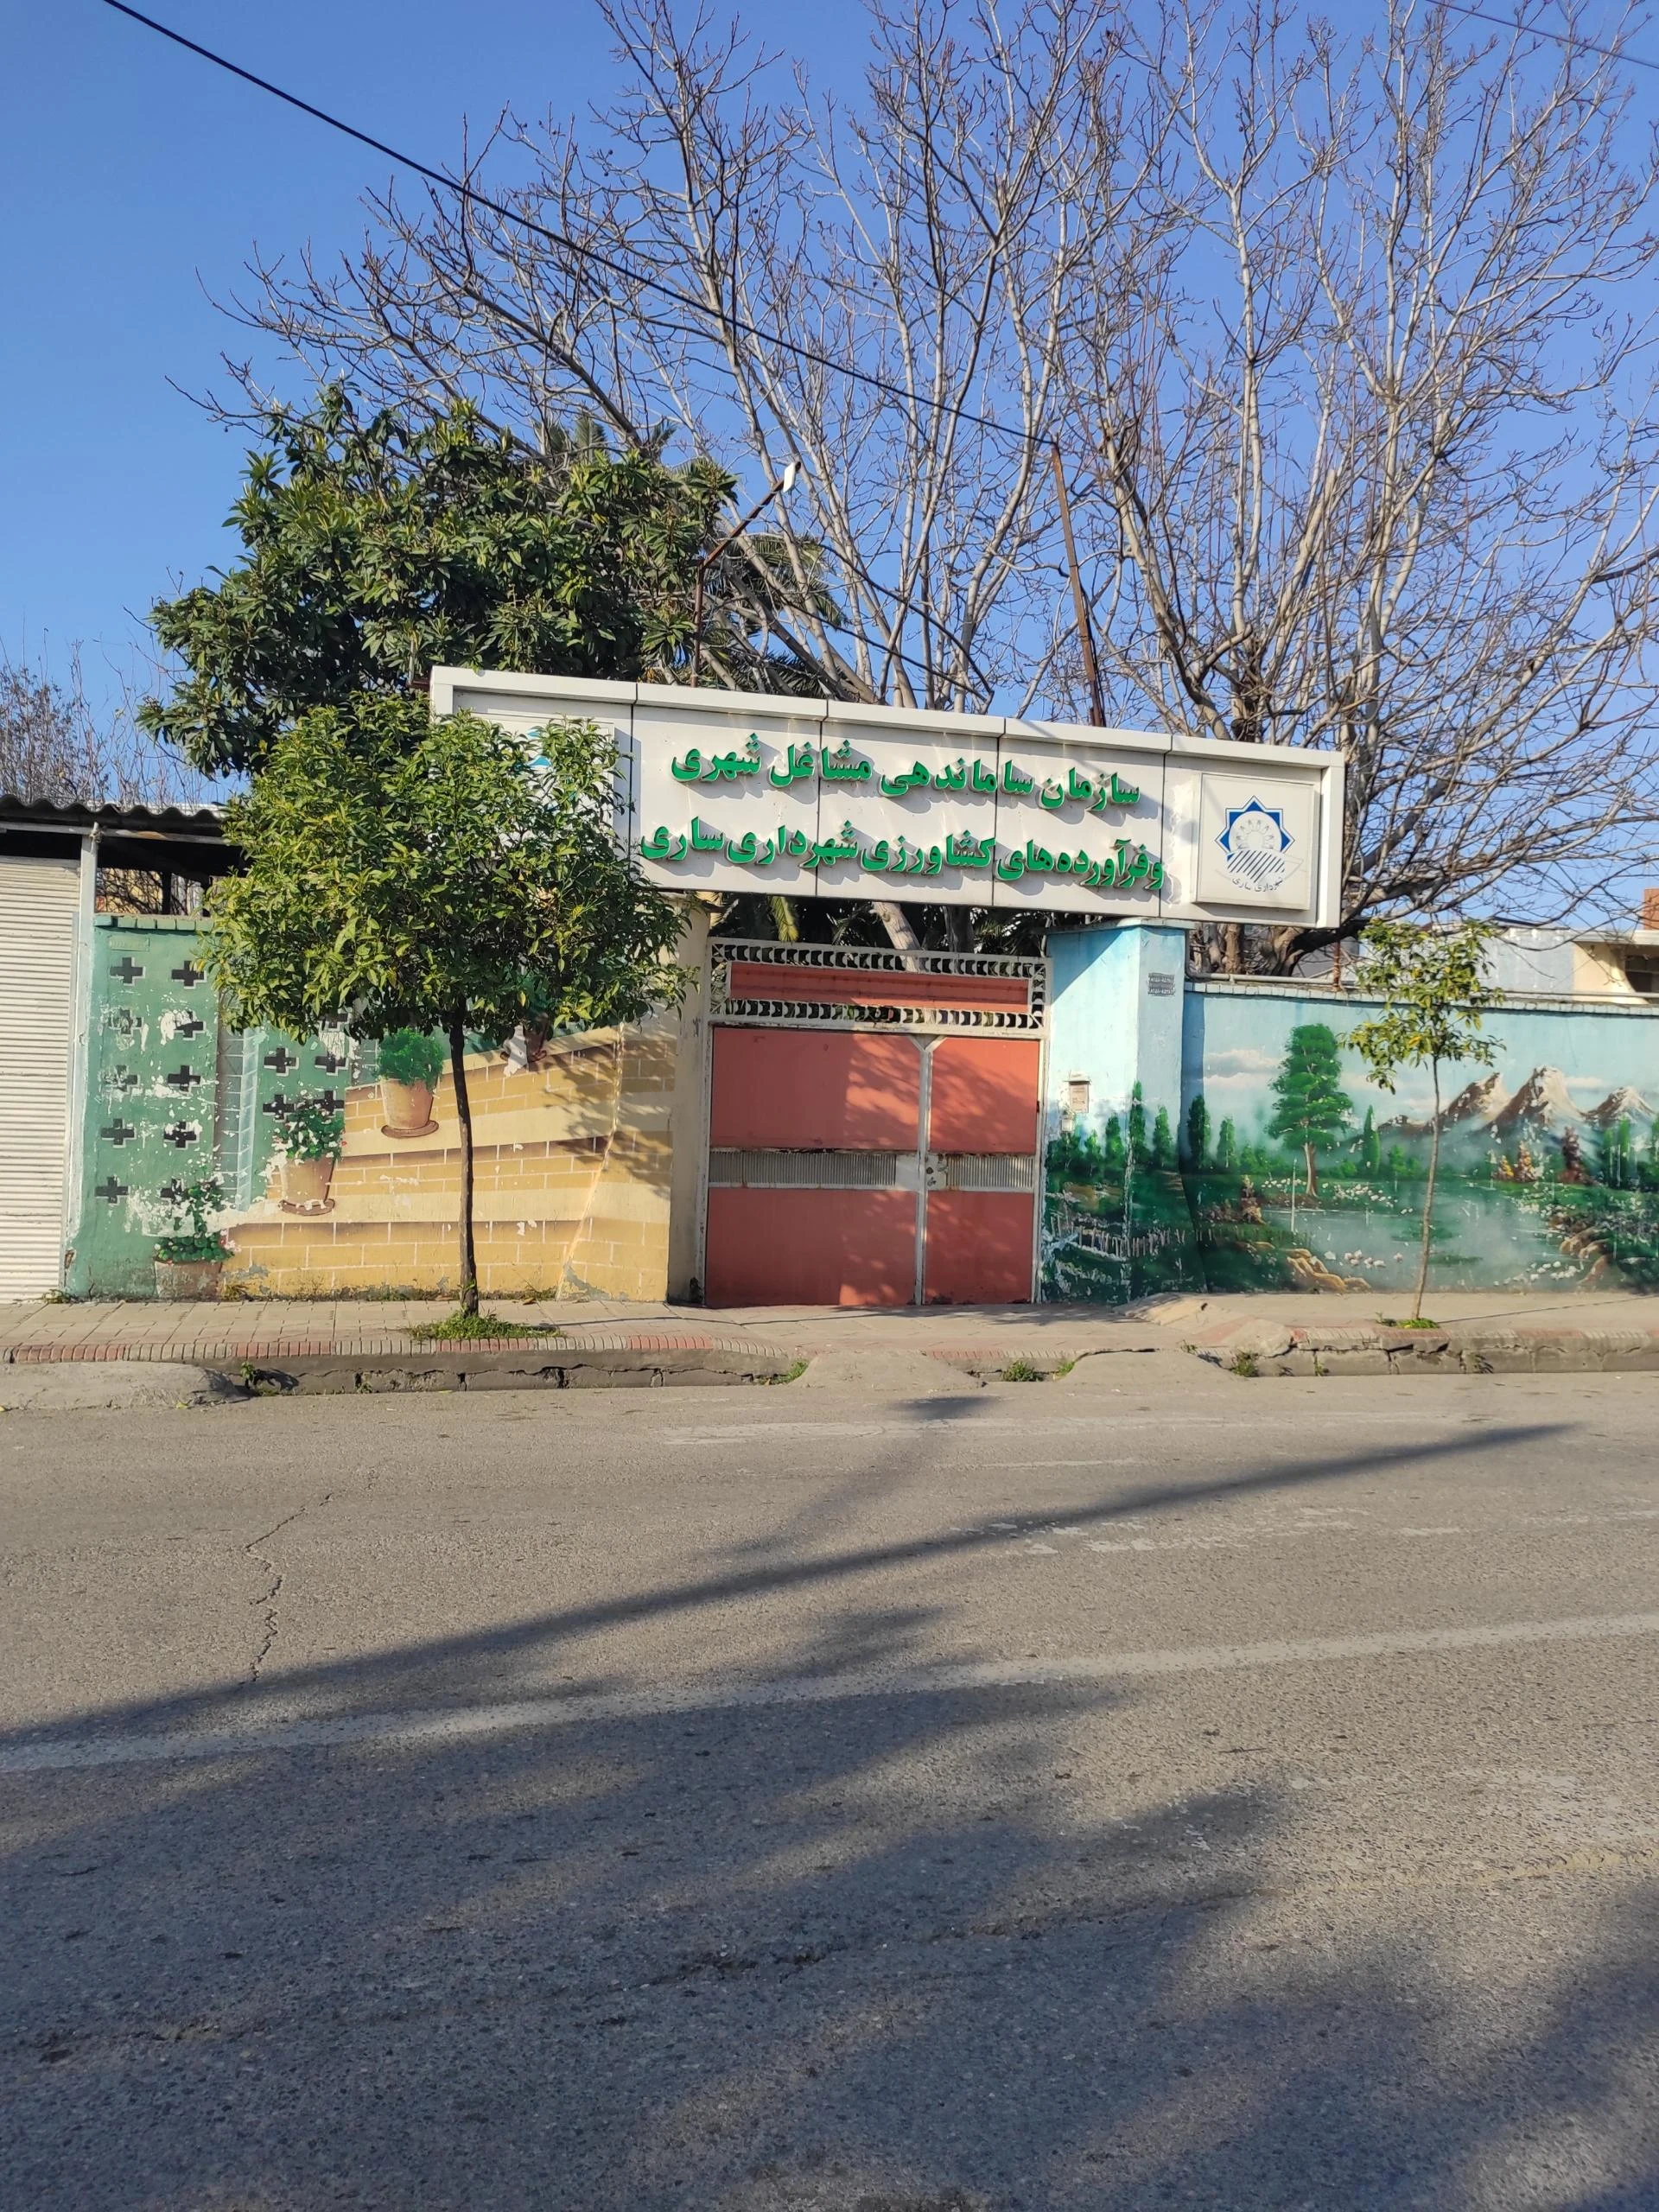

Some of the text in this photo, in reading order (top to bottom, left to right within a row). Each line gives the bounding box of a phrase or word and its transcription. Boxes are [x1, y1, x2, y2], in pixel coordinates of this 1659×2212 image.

[671, 732, 1141, 810] سازمان ساماندهی مشاغل شهری
[640, 815, 725, 861] ساری
[725, 819, 859, 868] شهرداری
[860, 829, 996, 875] کشاورزی
